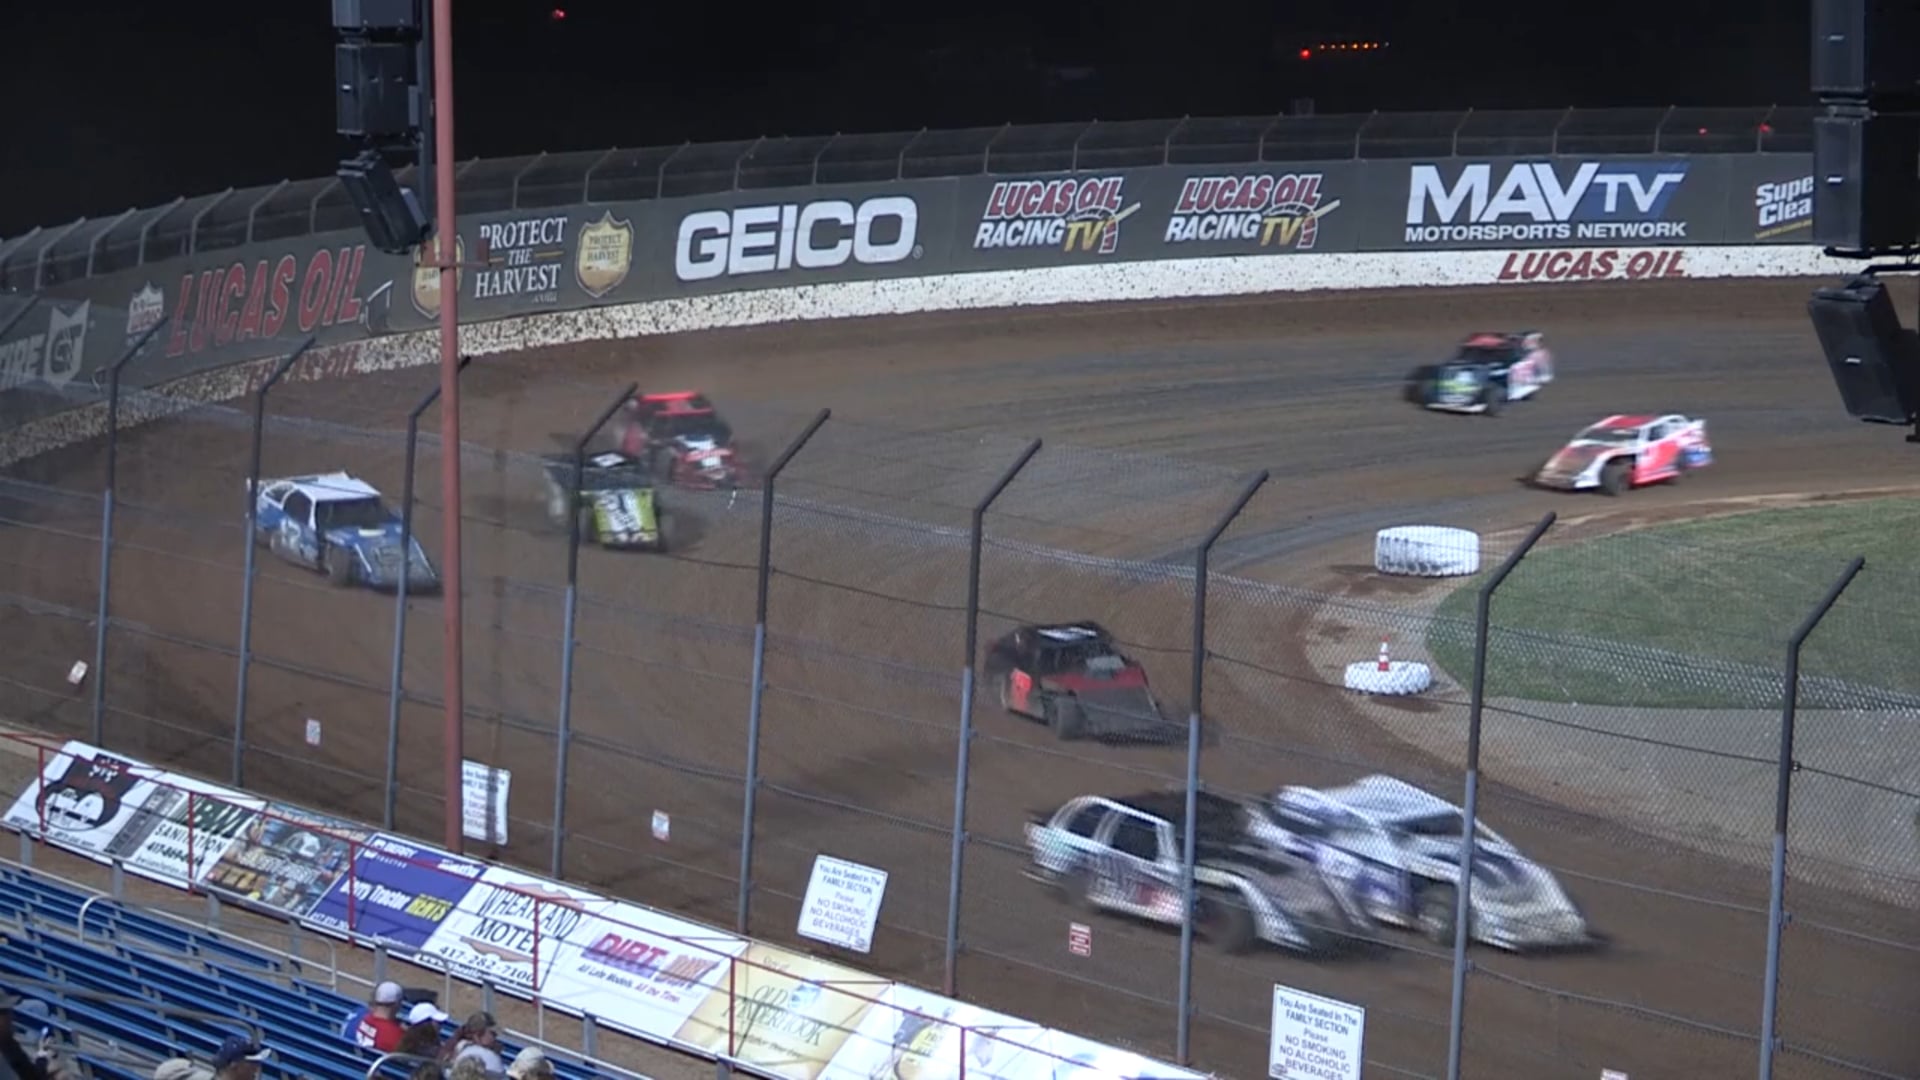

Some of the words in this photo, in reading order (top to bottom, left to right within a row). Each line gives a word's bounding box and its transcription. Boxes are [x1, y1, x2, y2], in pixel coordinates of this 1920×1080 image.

[984, 179, 1076, 219] LUCAS
[1077, 176, 1124, 212] OIL
[1174, 176, 1271, 214] LUCAS
[1271, 174, 1323, 207] OIL
[1756, 176, 1814, 207] Supe
[1759, 198, 1813, 227] Clea
[479, 217, 568, 250] PROTECT
[675, 196, 918, 281] GEICO
[1405, 224, 1570, 242] MOTORSPORTS
[1577, 222, 1687, 240] NETWORK
[508, 248, 533, 266] THE
[1498, 250, 1618, 281] LUCAS
[1625, 249, 1687, 277] OIL
[474, 263, 562, 298] HARVEST
[167, 254, 297, 357] LUCAS
[299, 245, 366, 333] OIL
[154, 823, 227, 854] SANITION
[809, 906, 823, 916] NO
[817, 898, 831, 907] NO
[590, 932, 669, 966] DIRT
[1280, 996, 1293, 1007] You
[1294, 1000, 1307, 1011] Are
[1344, 1013, 1357, 1026] The
[1286, 1009, 1314, 1024] FAMILY
[1314, 1017, 1349, 1036] SECTION
[1279, 1045, 1294, 1056] NO
[1295, 1049, 1351, 1074] ALCOHOLIC
[1285, 1034, 1300, 1046] NO
[1301, 1039, 1346, 1060] SMOKING
[1285, 1058, 1344, 1080] BEVERAGES
